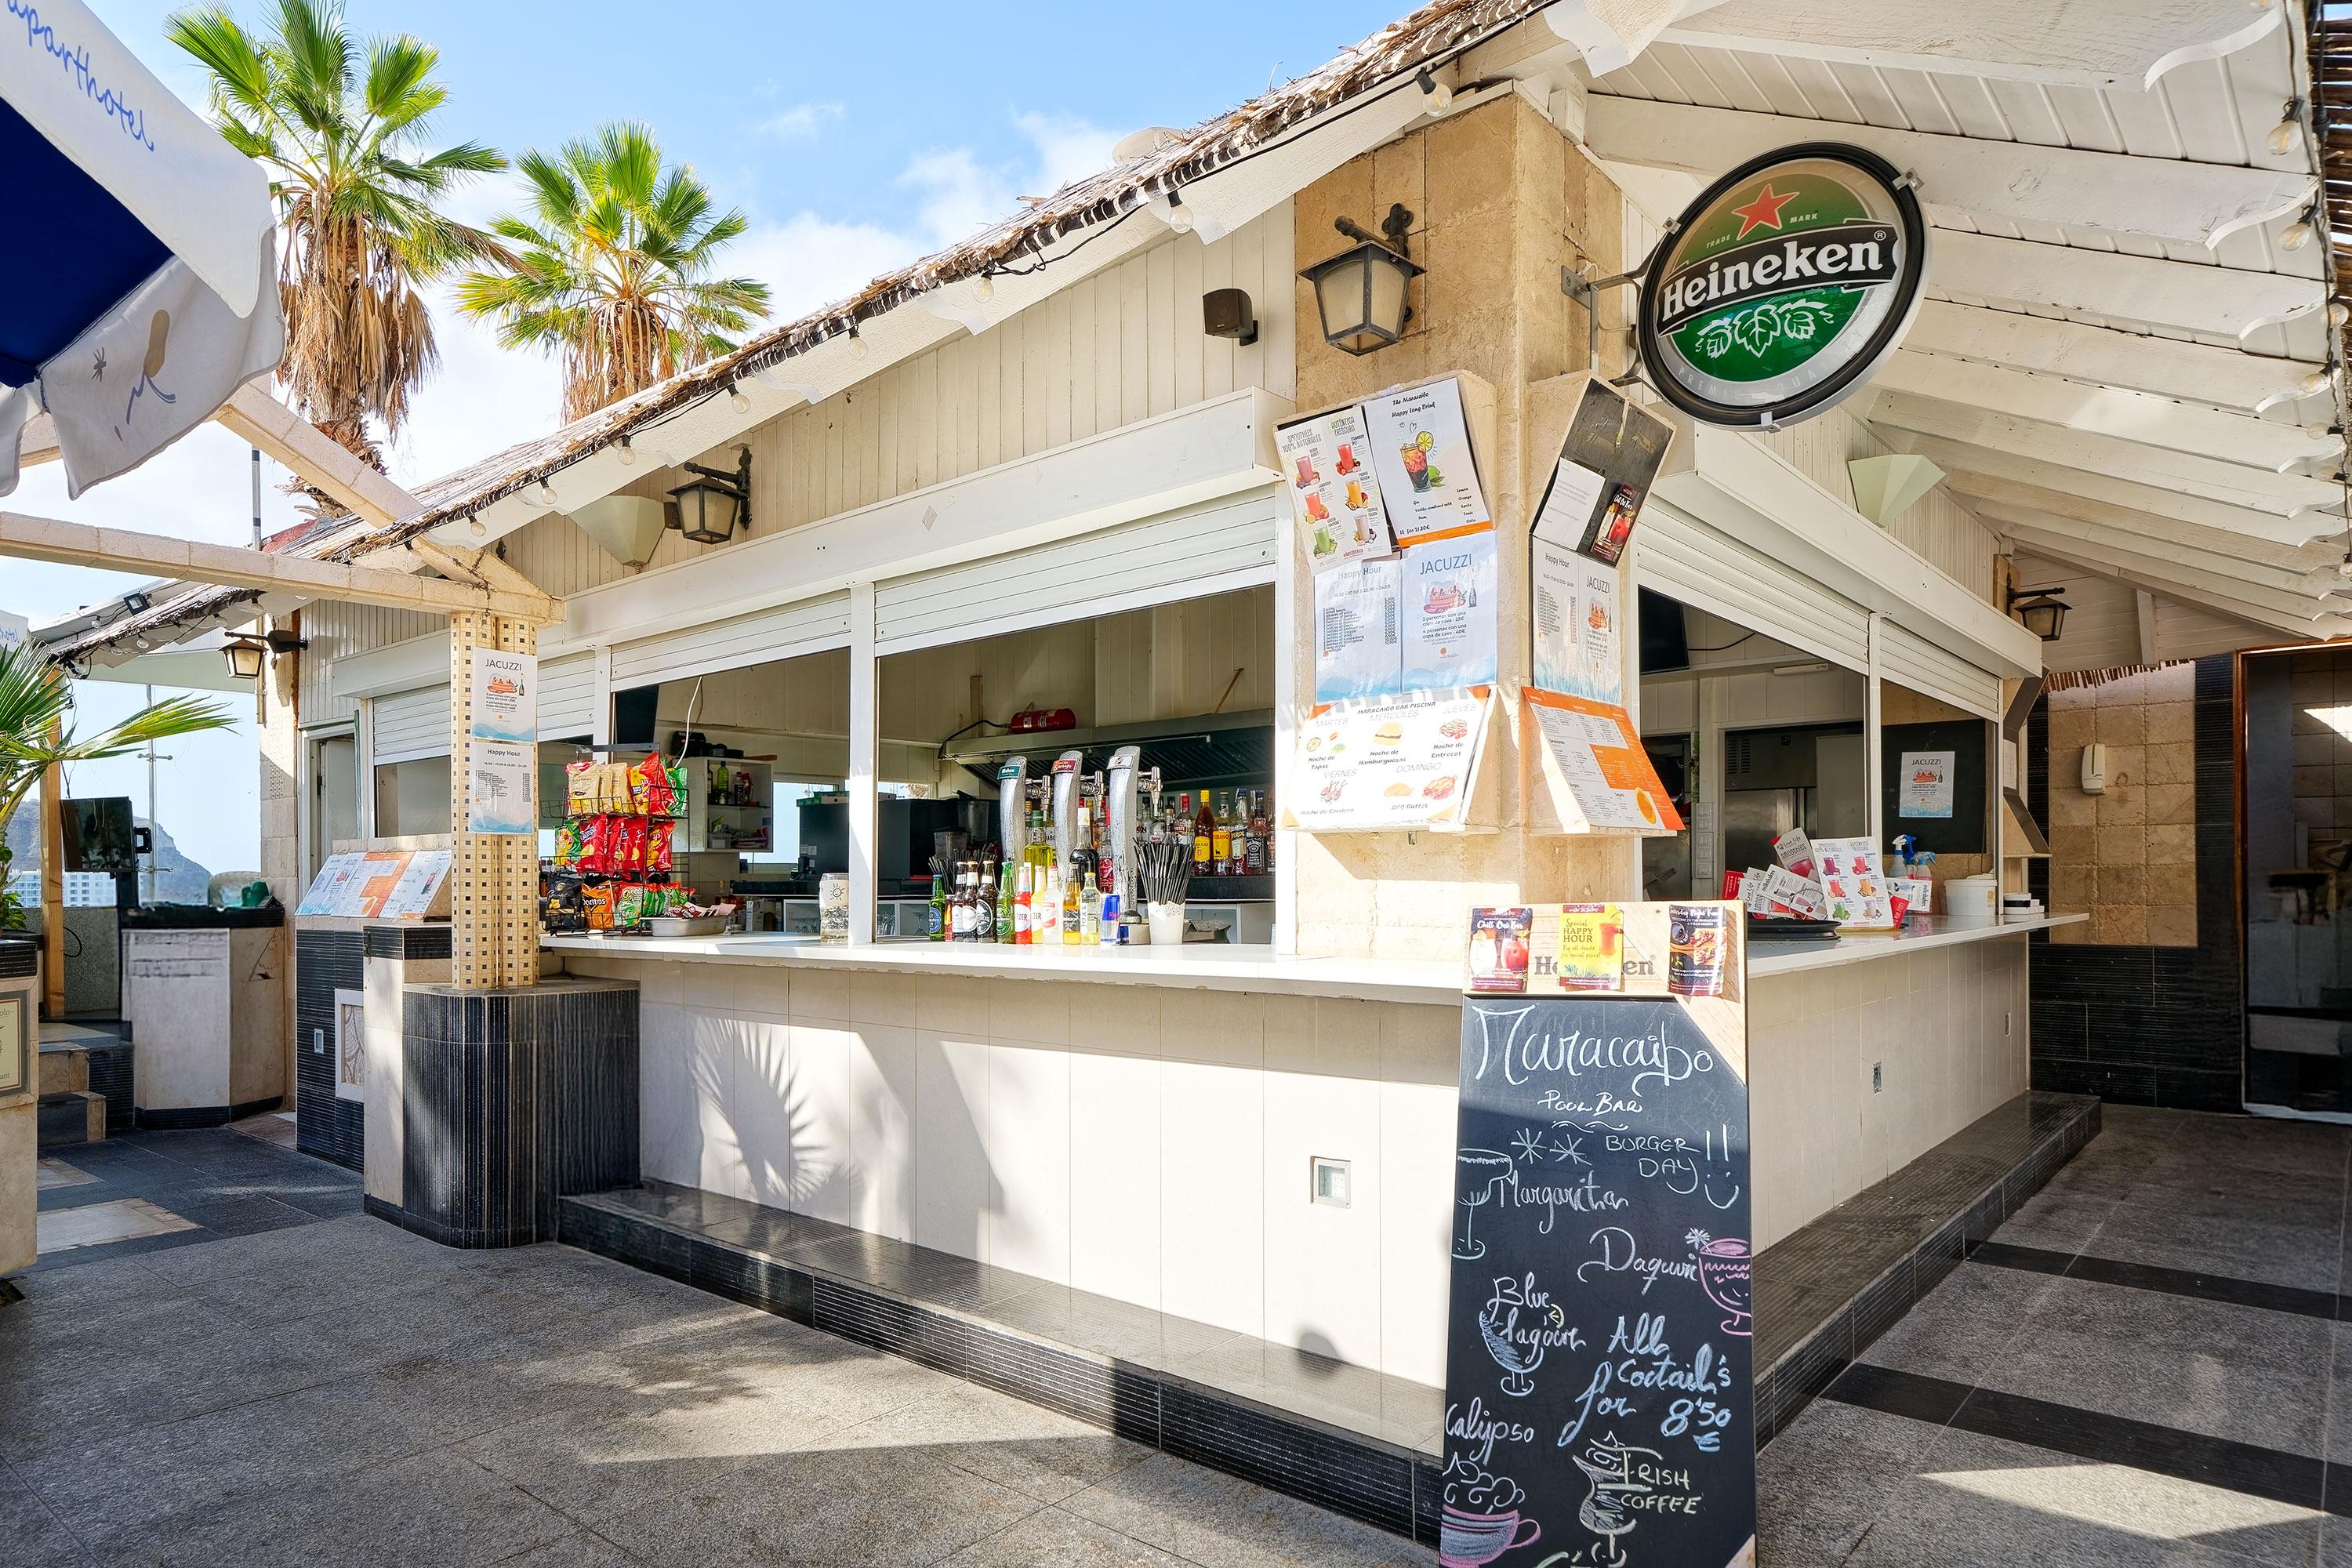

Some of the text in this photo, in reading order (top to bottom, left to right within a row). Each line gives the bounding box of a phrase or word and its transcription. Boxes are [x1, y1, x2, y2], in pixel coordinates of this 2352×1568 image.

[6, 0, 155, 152] aparthotel
[1705, 212, 1818, 249] TRADE MARK
[1661, 240, 1883, 322] Heineken
[1402, 391, 1429, 403] Maracaibo
[1421, 401, 1436, 410] Drink
[1287, 428, 1314, 444] SMOOTHIES
[1296, 434, 1323, 450] NATURALES
[1419, 553, 1472, 575] JACUZZI
[1338, 566, 1382, 580] Happy Hour
[1586, 575, 1610, 593] JACUZZI
[485, 658, 523, 672] JACUZZI
[1323, 768, 1358, 779] VIERNES
[1780, 843, 1808, 860] smoothies
[1476, 920, 1524, 930] Chill Out Bar
[1566, 918, 1588, 928] Special
[1563, 935, 1593, 943] HOUR
[1472, 1004, 1714, 1098] Maracaibo
[1605, 1134, 1701, 1155] BURGER
[1638, 1157, 1700, 1195] DAY
[1486, 1272, 1551, 1323] Blue
[1621, 1493, 1702, 1514] COFFEE
